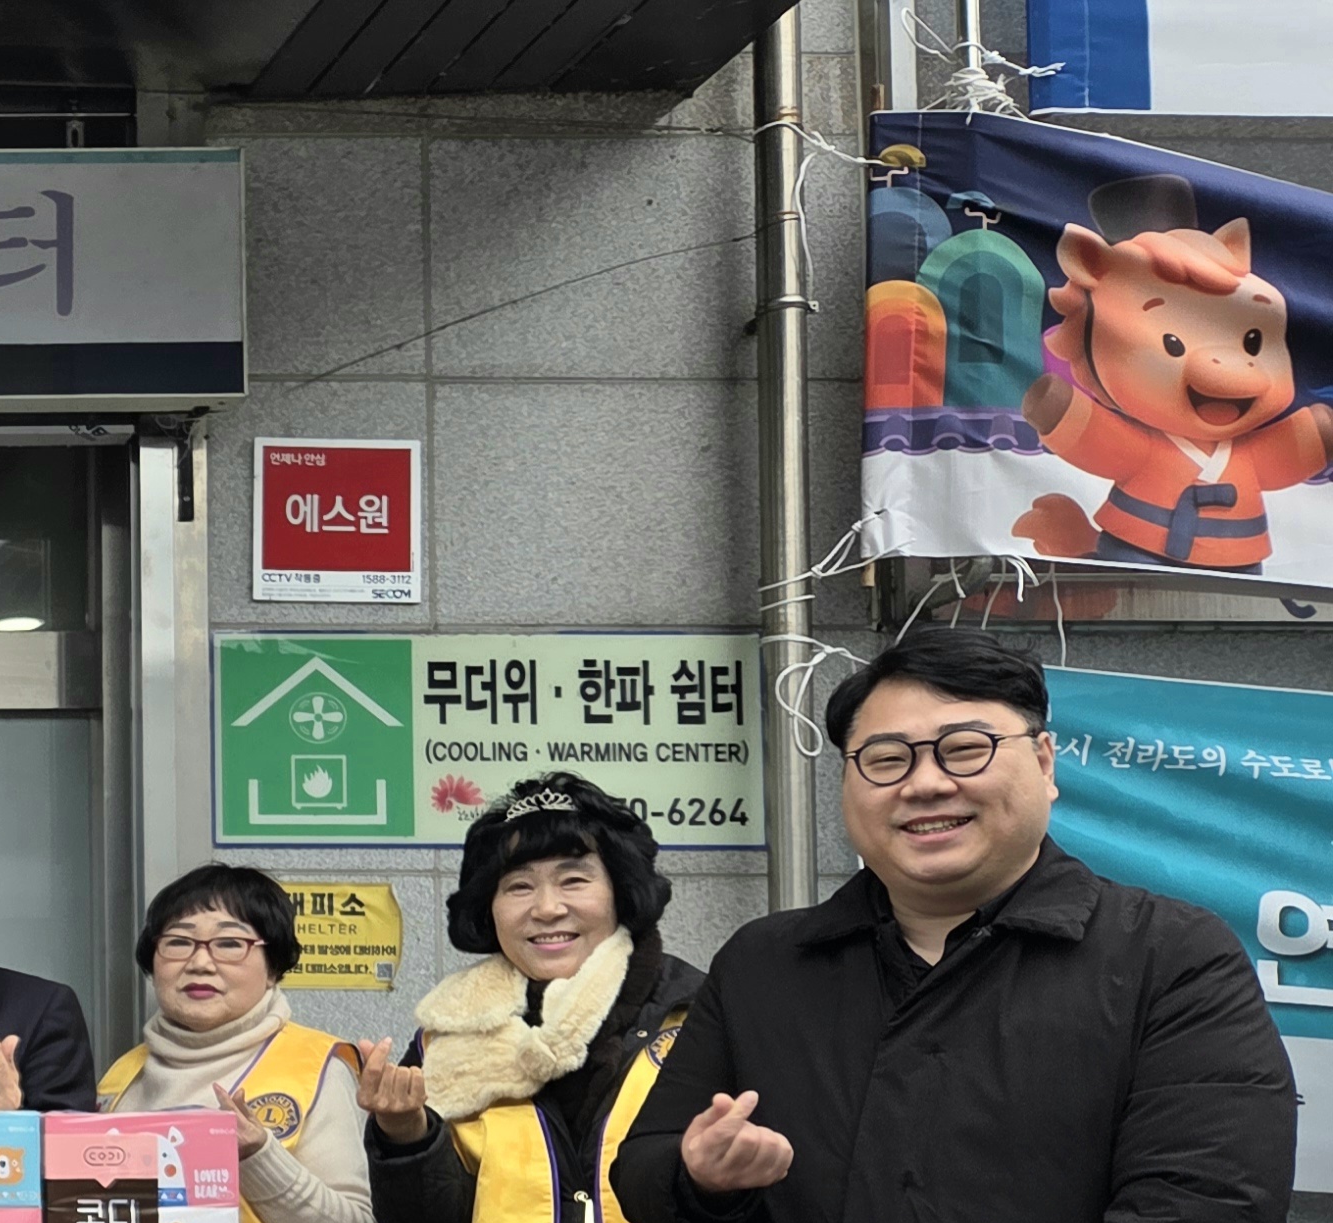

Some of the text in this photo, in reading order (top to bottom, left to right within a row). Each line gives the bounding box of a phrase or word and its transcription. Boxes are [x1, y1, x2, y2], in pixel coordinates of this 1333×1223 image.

[270, 453, 326, 467] 언제나 안심
[285, 493, 390, 535] 에스원
[261, 573, 292, 584] CCTV
[362, 575, 412, 585] 1588-3112
[371, 589, 412, 599] SECOM
[423, 659, 538, 725] 무더위
[577, 659, 655, 725] 한파
[670, 660, 744, 726] 쉼터
[425, 738, 529, 764] (COOLING
[546, 741, 648, 763] WARMING
[654, 739, 750, 765] CENTER)
[1102, 737, 1227, 777] 전라도의
[631, 798, 749, 826] 0-6264
[296, 923, 358, 936] HELTER
[194, 1168, 229, 1184] LOVELY
[194, 1185, 219, 1199] BEAR
